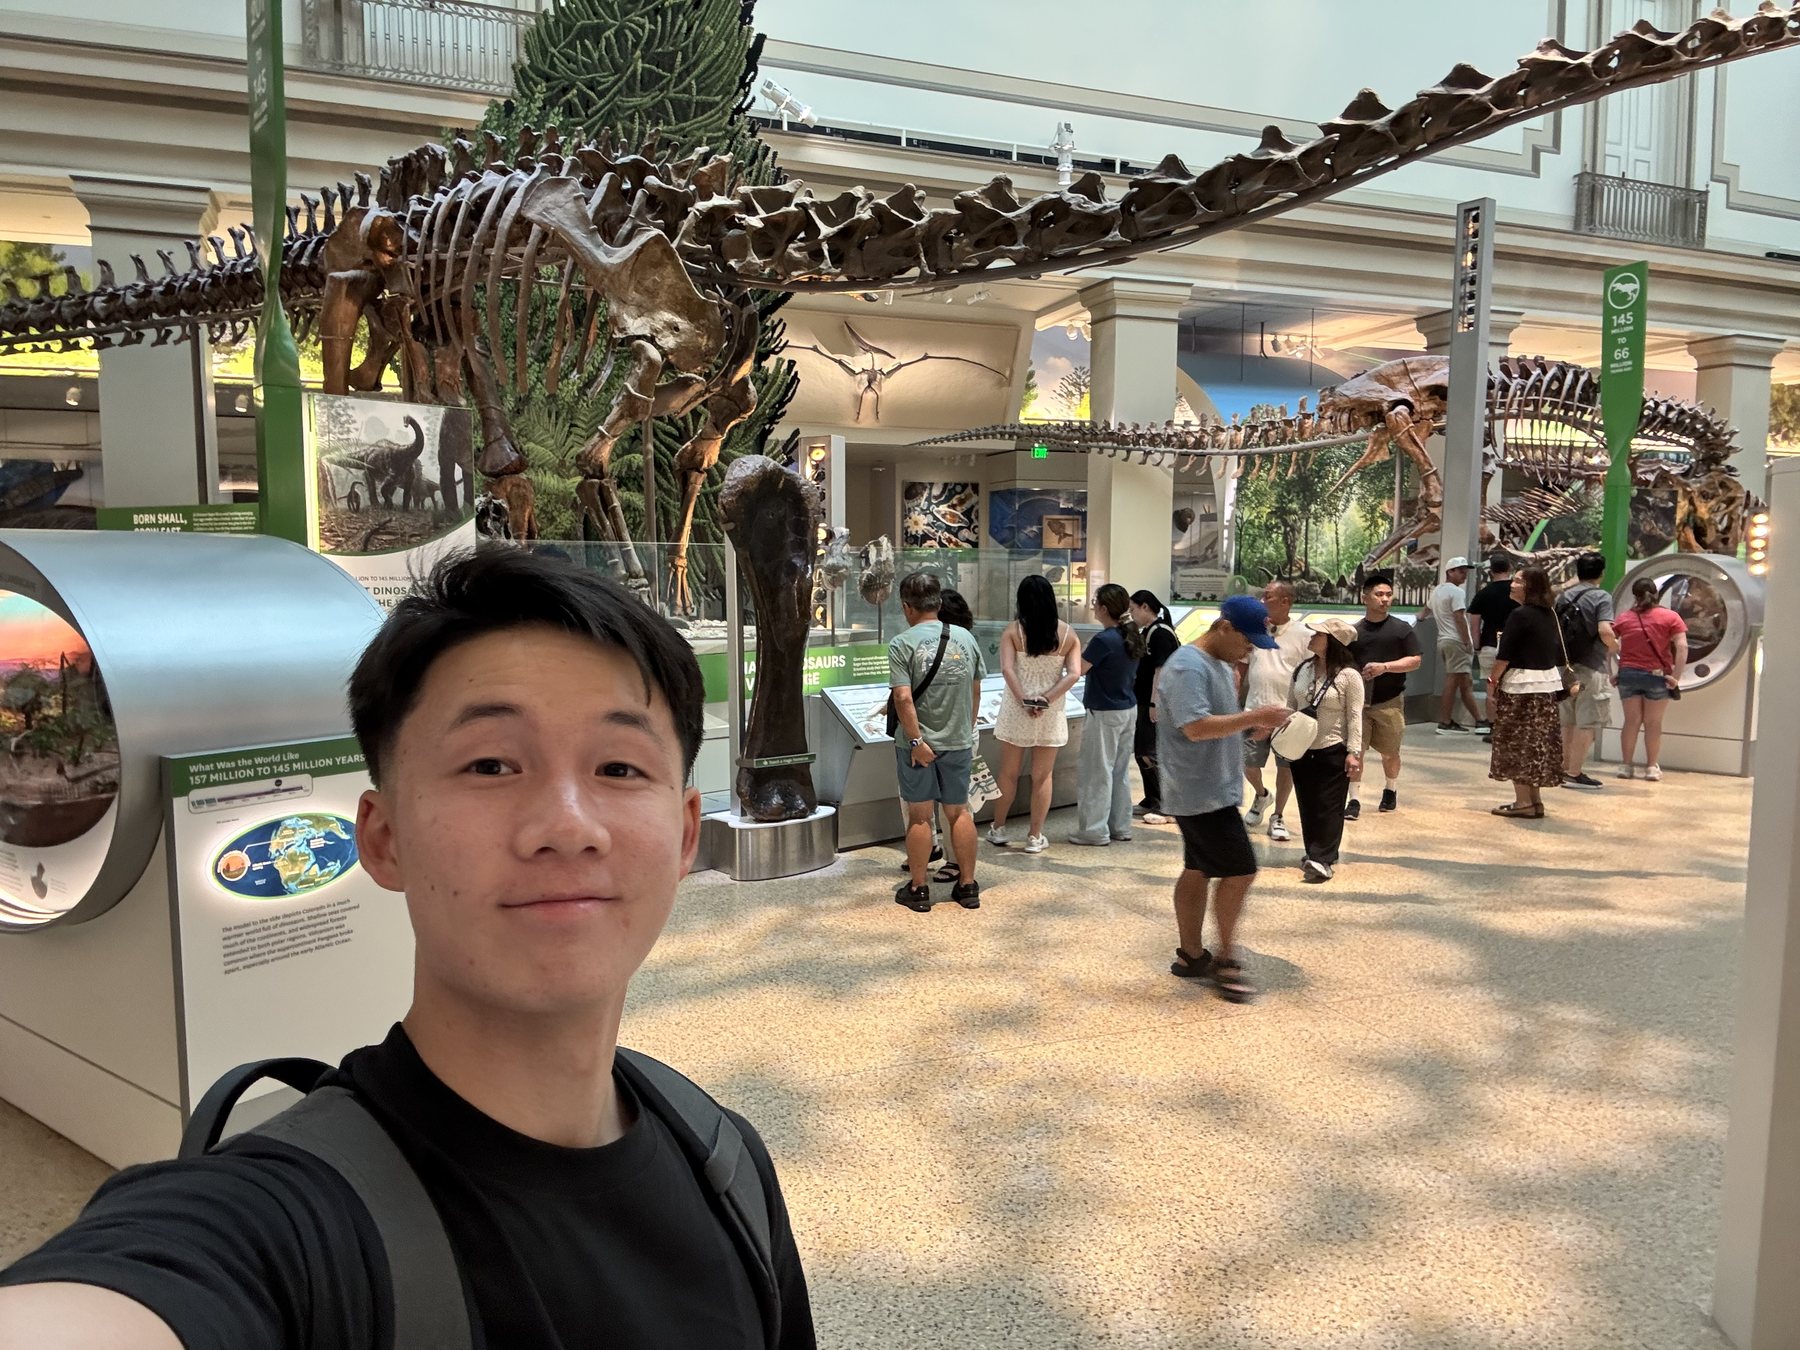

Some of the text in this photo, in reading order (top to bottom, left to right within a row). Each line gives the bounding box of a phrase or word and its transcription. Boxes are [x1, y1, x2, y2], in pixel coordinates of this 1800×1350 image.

[1611, 312, 1634, 327] 145
[1611, 326, 1634, 334] MILLION
[1614, 348, 1630, 360] 66
[133, 513, 156, 525] BORN
[157, 513, 187, 525] SMALL,
[373, 586, 407, 595] DINOS
[803, 655, 846, 670] OSAURS
[189, 752, 300, 773] What Was the World Like
[189, 753, 366, 785] 157 MILLION TO 145 MILLION YEARS
